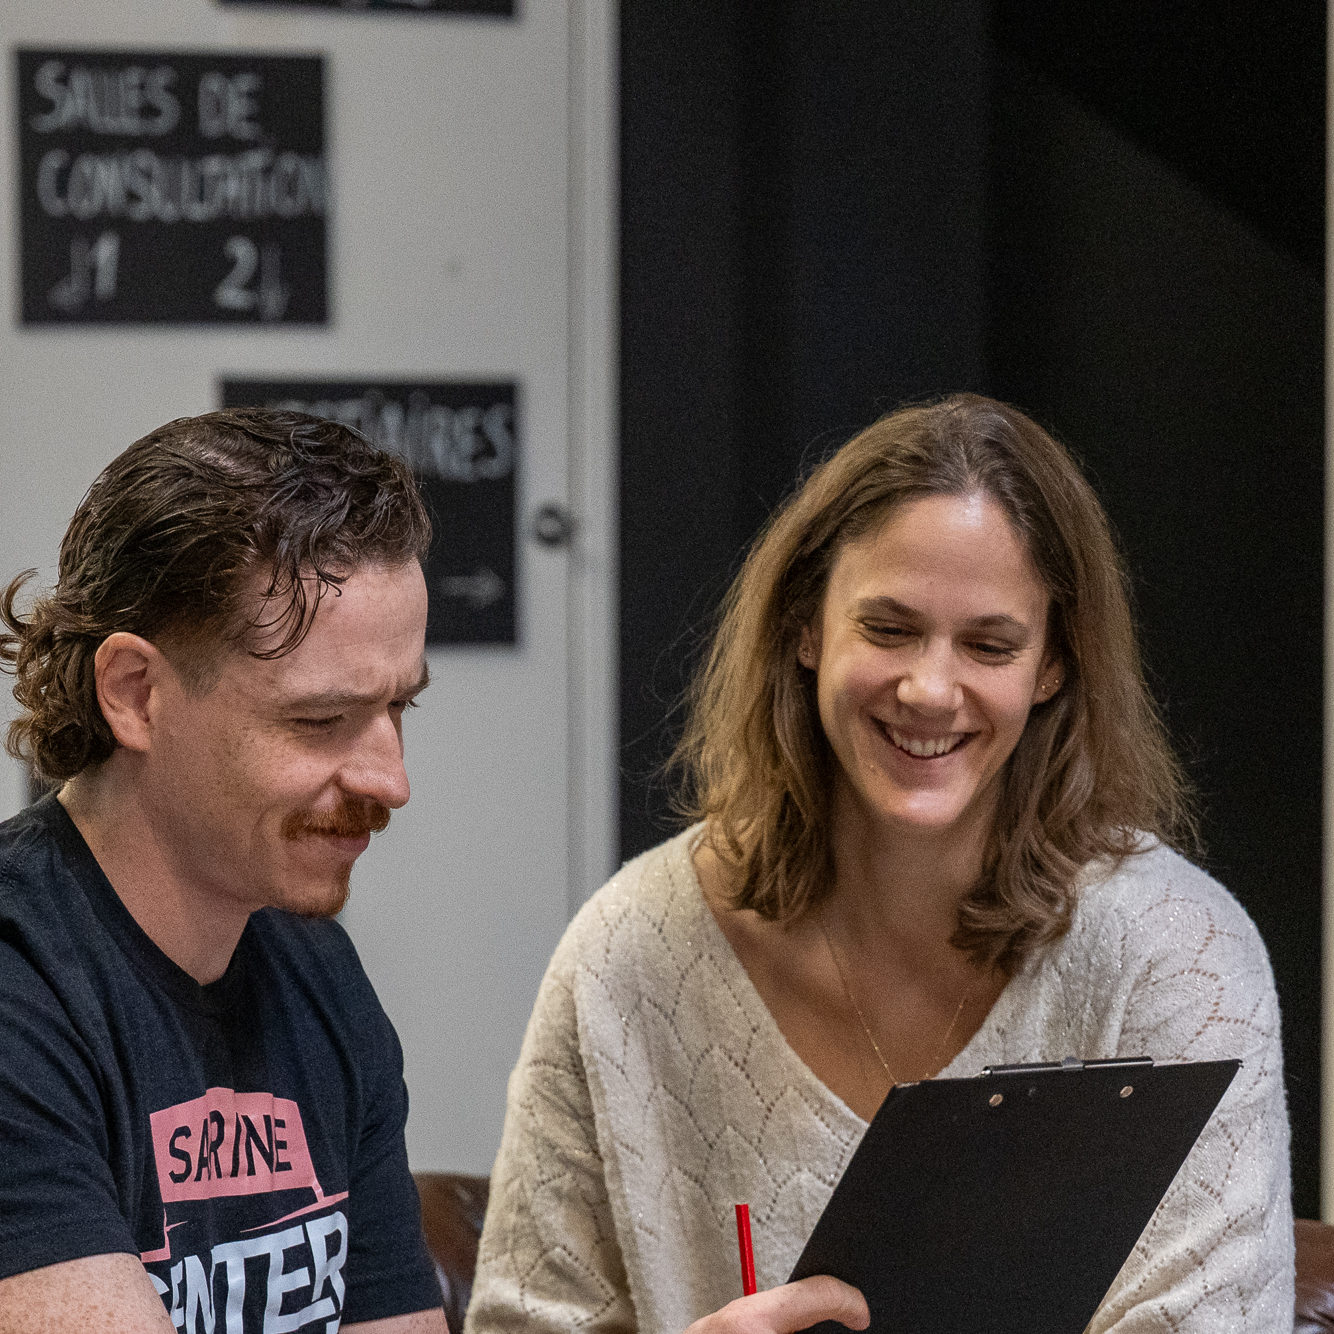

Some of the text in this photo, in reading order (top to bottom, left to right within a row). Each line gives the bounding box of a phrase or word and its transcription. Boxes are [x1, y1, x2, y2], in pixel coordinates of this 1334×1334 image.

[197, 70, 265, 140] DE
[215, 234, 260, 310] 2
[167, 1109, 294, 1184] SARINE
